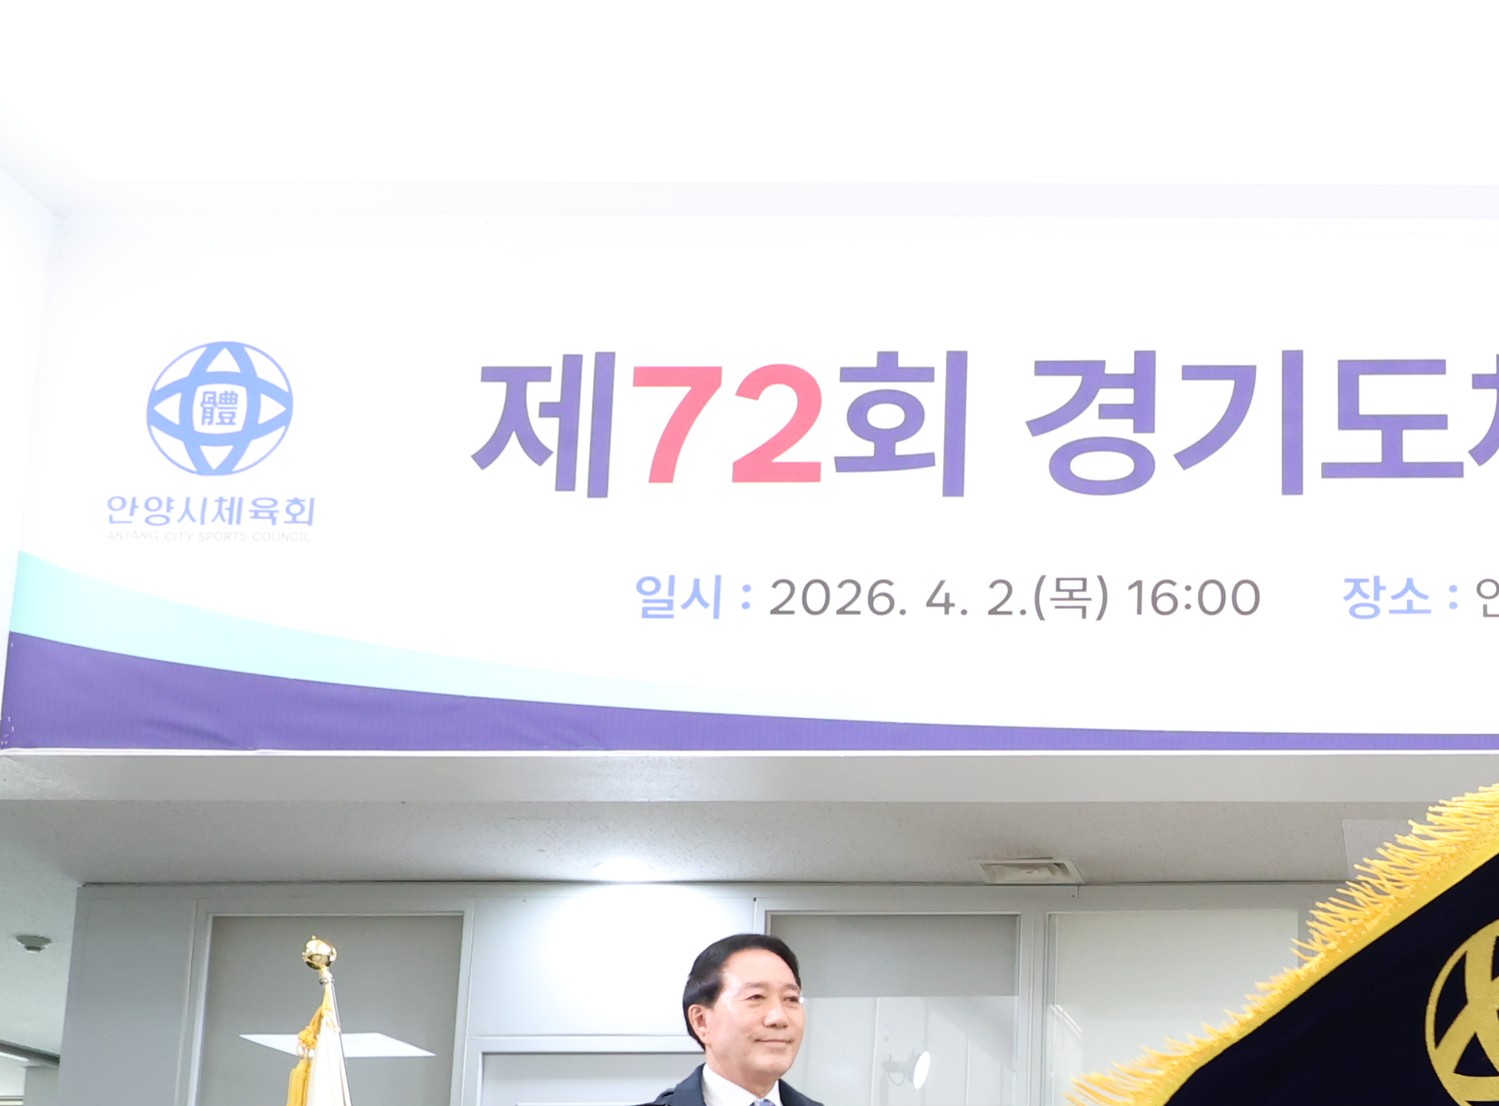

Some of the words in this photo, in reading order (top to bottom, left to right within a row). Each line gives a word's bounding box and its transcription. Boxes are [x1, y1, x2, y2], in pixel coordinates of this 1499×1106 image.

[471, 351, 968, 498] 제72회
[107, 495, 315, 526] 안양시체육회
[106, 530, 159, 542] ANYANG
[163, 531, 194, 542] CITY
[198, 531, 248, 543] SPORTS
[252, 531, 311, 543] COUNCIL
[635, 574, 722, 620] 일시
[769, 578, 907, 616] 2026.
[925, 579, 968, 616] 4.
[987, 574, 1108, 621] 2.(목)
[1128, 579, 1261, 616] 16:00
[1343, 575, 1432, 620] 장소
